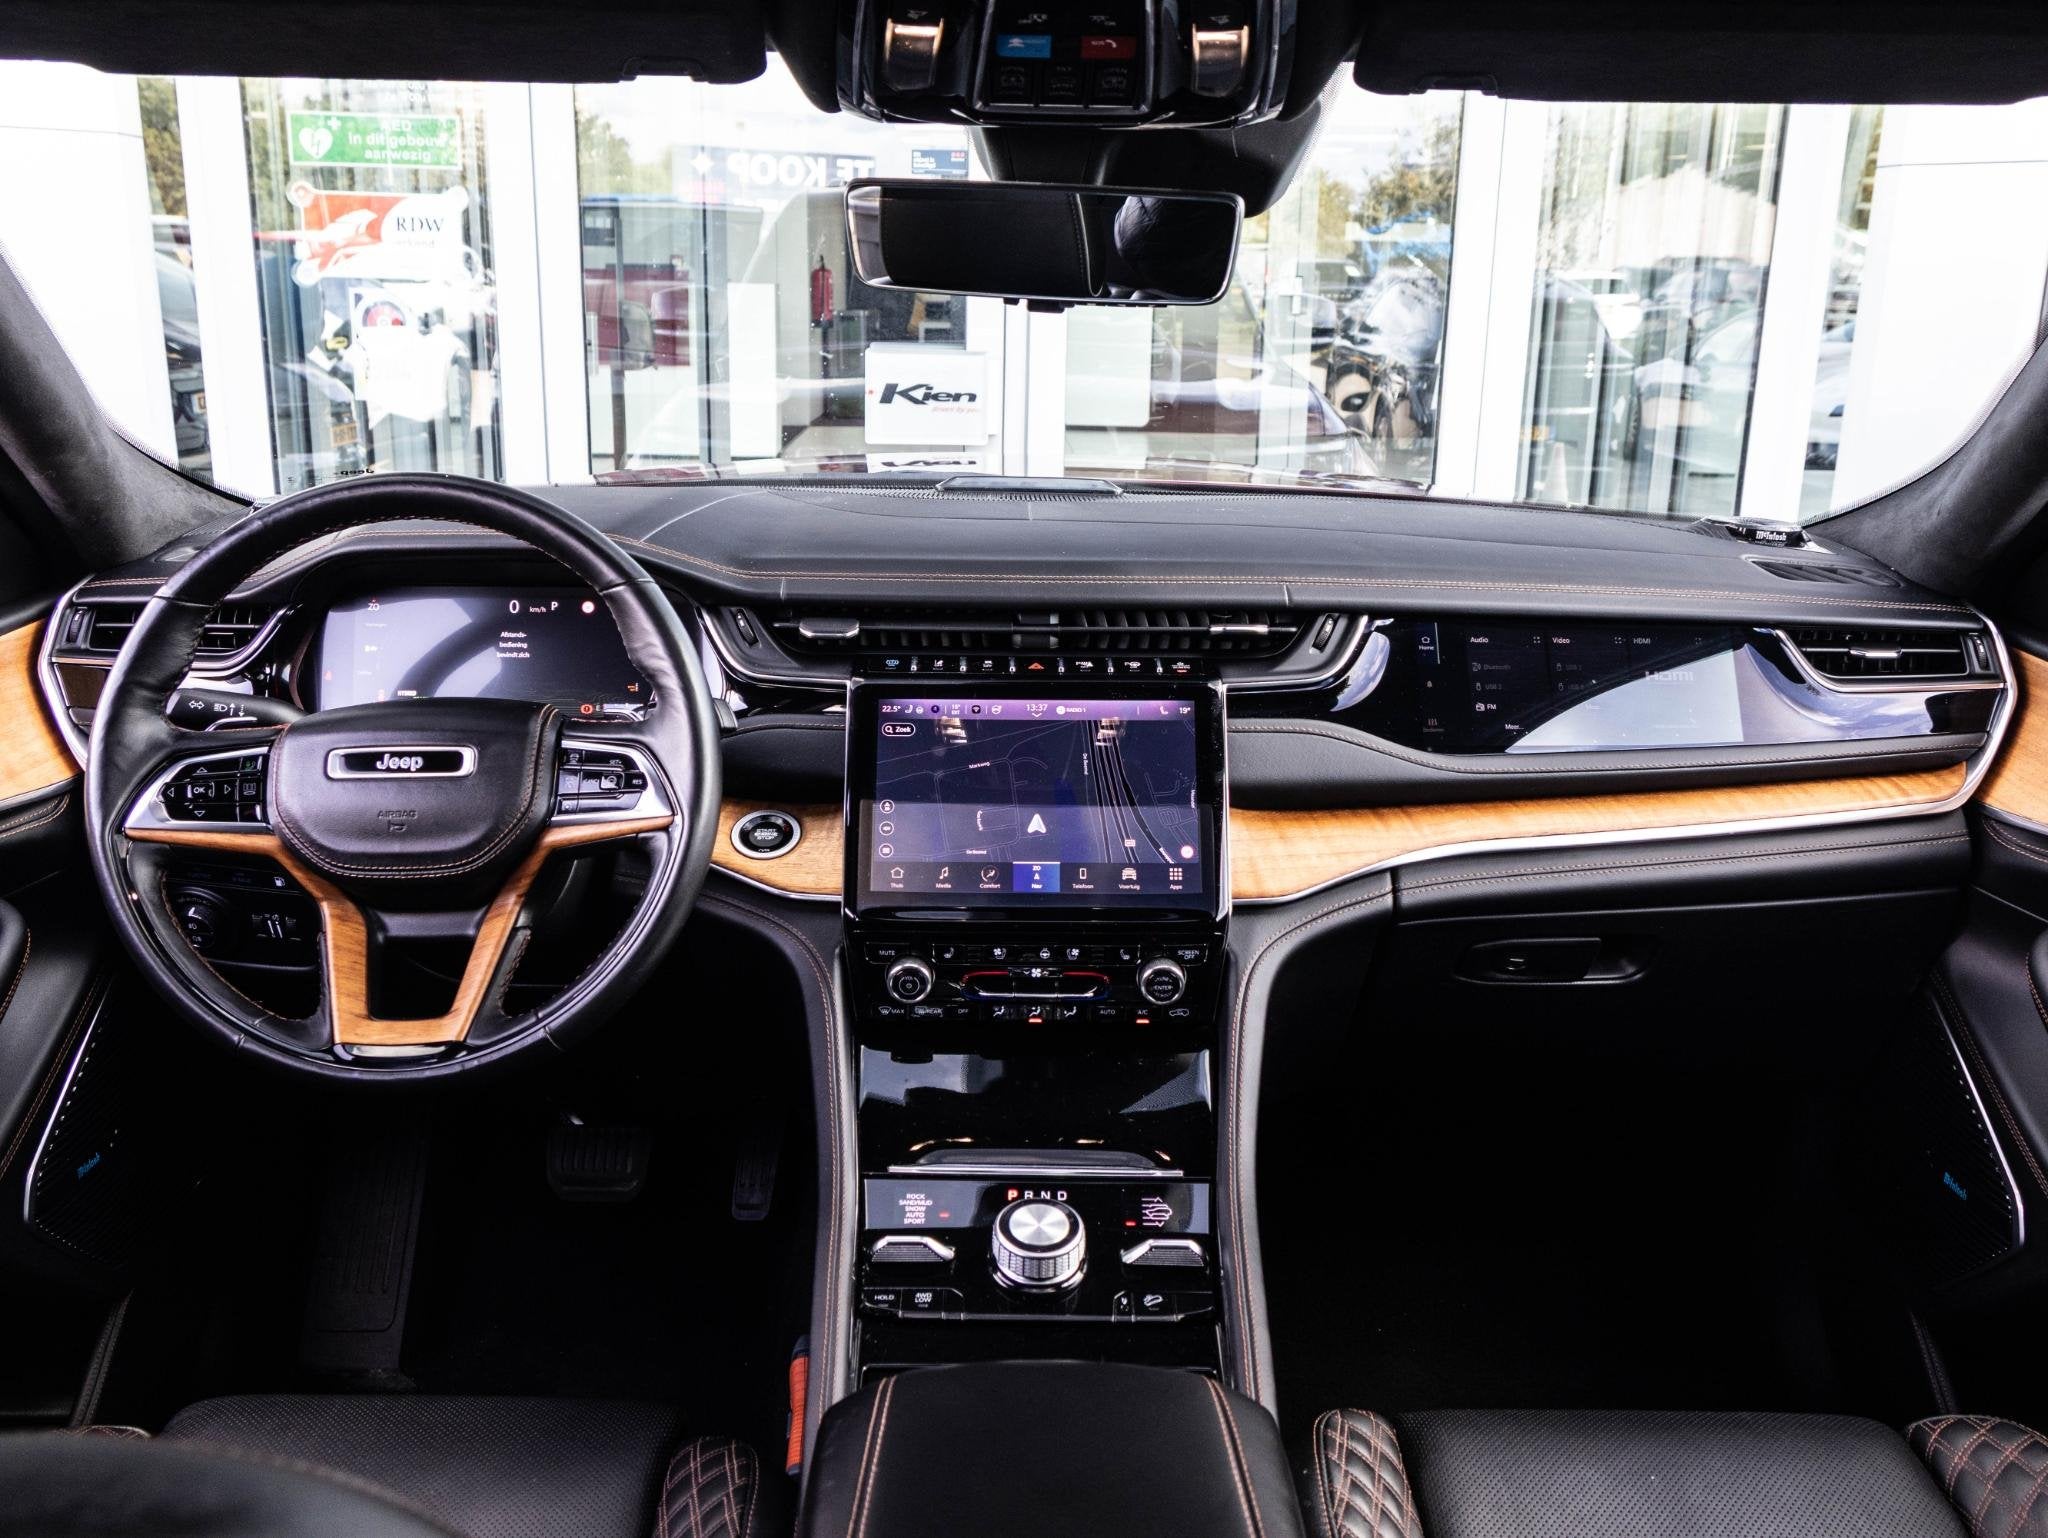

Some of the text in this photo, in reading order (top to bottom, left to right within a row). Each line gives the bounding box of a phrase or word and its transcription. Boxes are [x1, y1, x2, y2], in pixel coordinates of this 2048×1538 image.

[366, 133, 385, 145] dit
[364, 149, 432, 162] aanwezig
[396, 216, 445, 233] RDW
[879, 383, 977, 405] Kien
[551, 601, 558, 610] P
[1633, 637, 1651, 645] HDMI
[1026, 703, 1048, 712] 13:37
[376, 754, 424, 772] Jeep
[193, 786, 206, 794] OK
[377, 810, 418, 820] AIRBAG
[1008, 1189, 1068, 1200] P R N D
